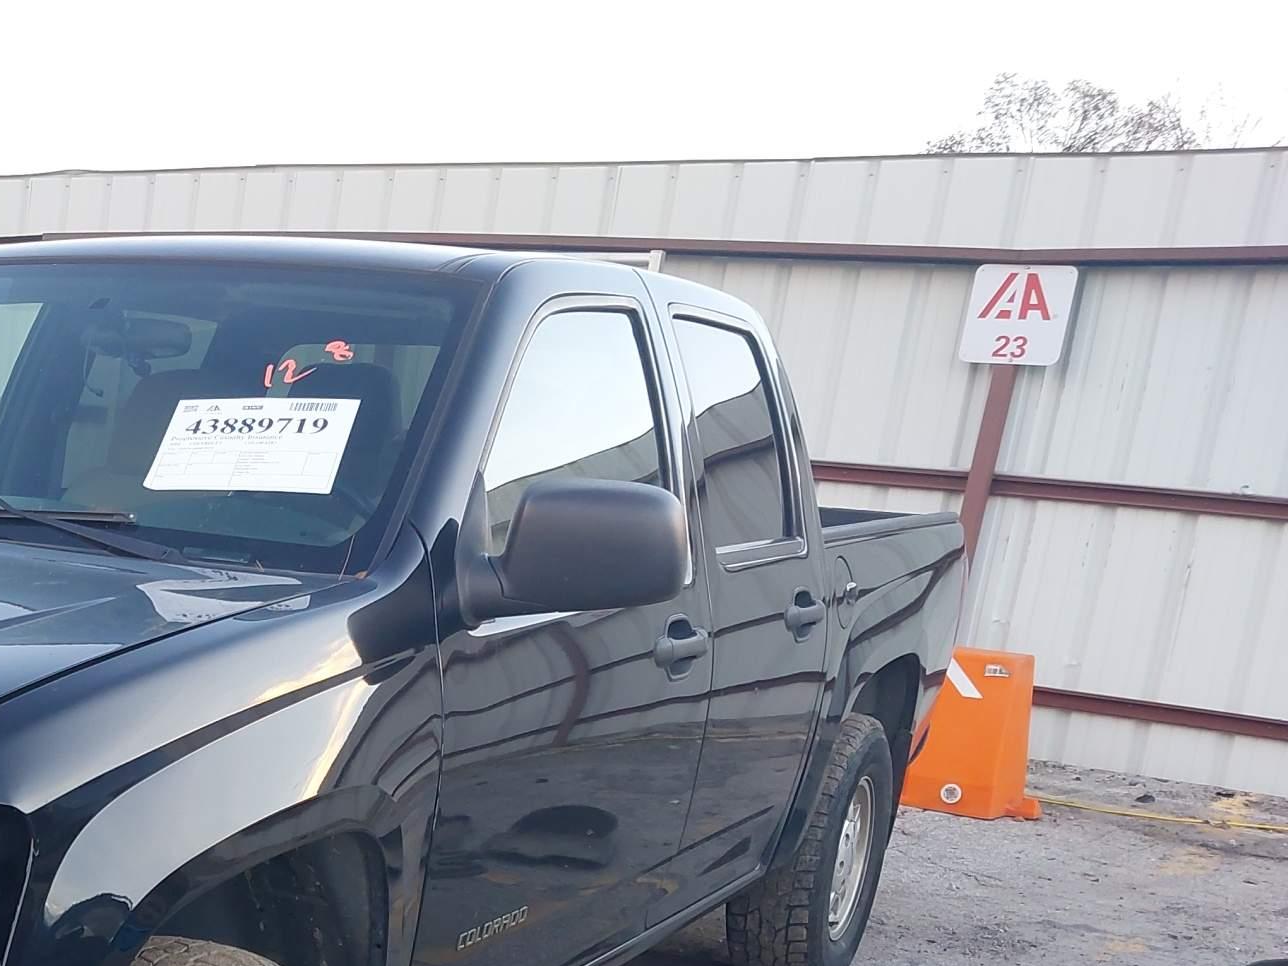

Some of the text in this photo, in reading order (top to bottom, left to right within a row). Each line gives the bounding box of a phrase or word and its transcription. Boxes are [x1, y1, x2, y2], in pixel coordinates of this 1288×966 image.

[991, 335, 1028, 358] 23
[264, 359, 317, 387] 12
[185, 417, 329, 434] 43889719
[456, 905, 528, 951] COLORADO
